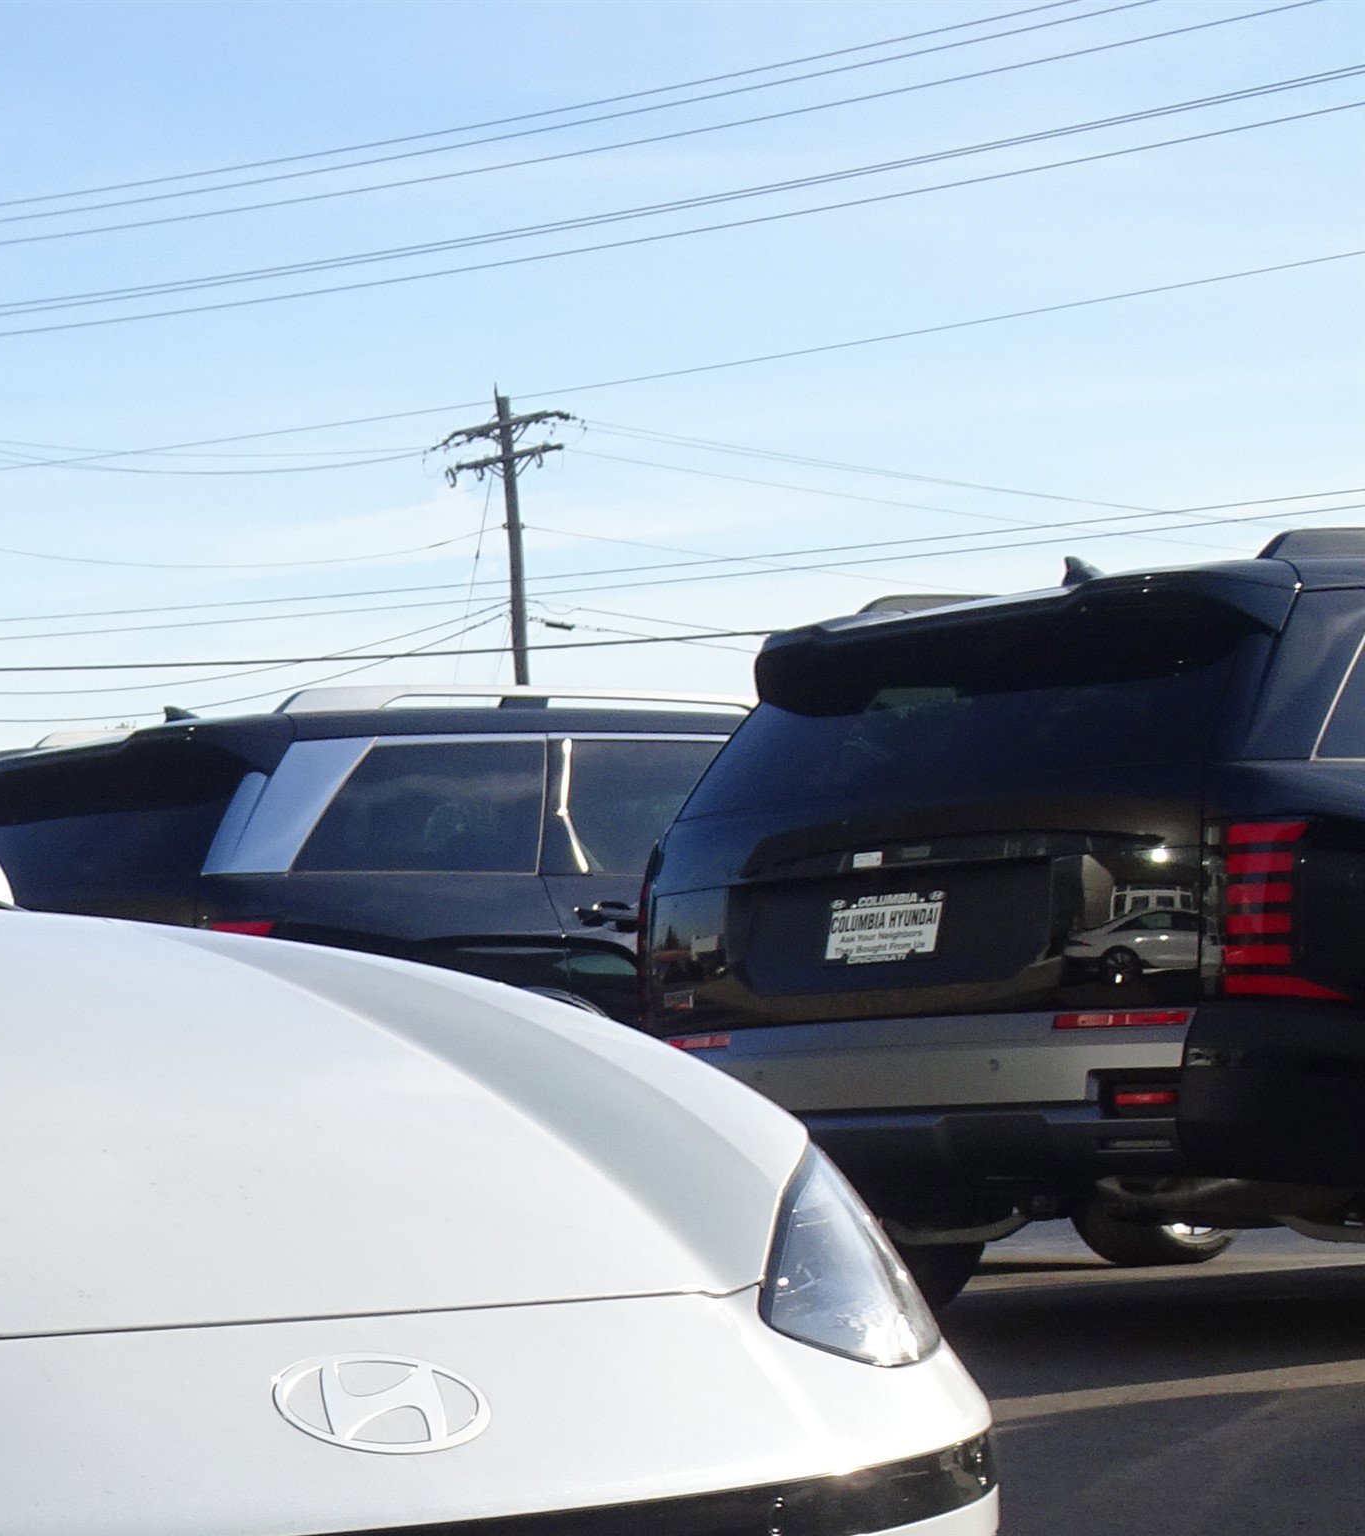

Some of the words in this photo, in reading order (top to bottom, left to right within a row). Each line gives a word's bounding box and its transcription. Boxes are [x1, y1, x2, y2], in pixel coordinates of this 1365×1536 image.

[857, 892, 918, 908] COLUMBIA
[830, 911, 886, 934] COLUMBIA
[888, 907, 939, 929] HYUNDAI
[840, 935, 856, 943] Ask
[857, 933, 877, 942] Your
[878, 930, 923, 940] Neighbors
[835, 946, 854, 956] They
[855, 943, 887, 953] Bought
[889, 941, 912, 950] From
